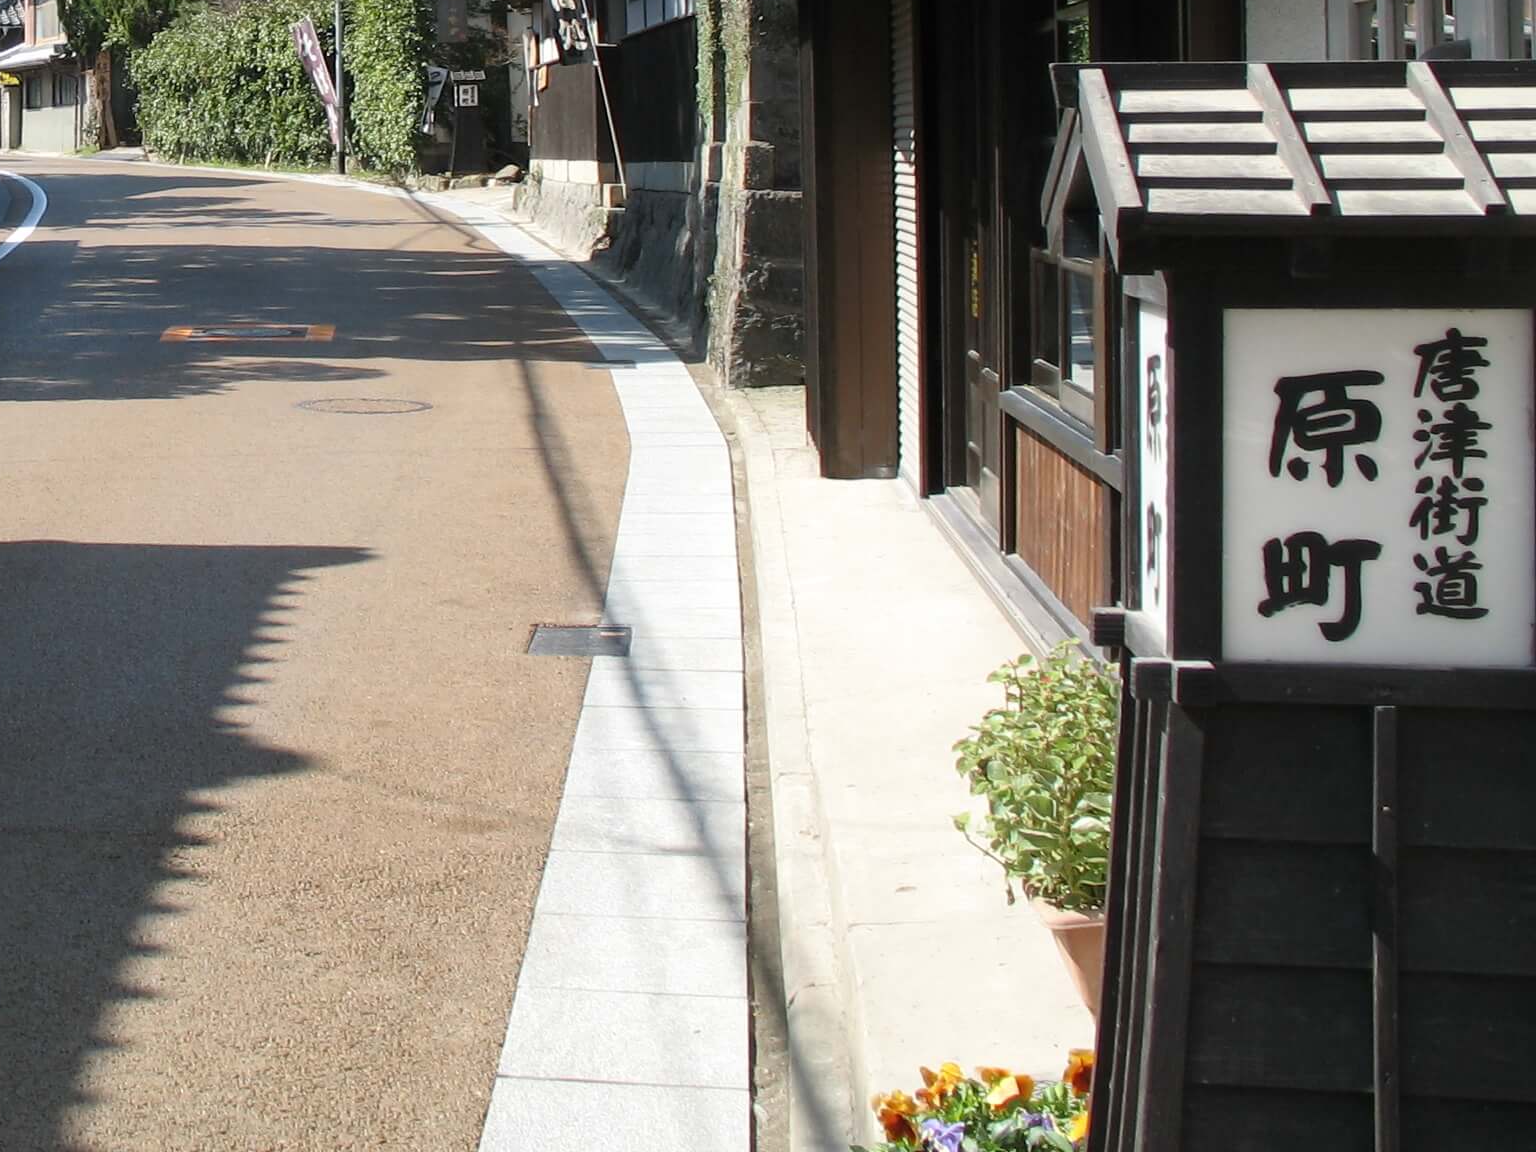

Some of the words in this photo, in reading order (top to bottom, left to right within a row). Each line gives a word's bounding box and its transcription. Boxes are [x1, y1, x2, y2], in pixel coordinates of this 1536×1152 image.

[1257, 369, 1385, 643] 原町
[1409, 327, 1493, 621] 唐津街道
